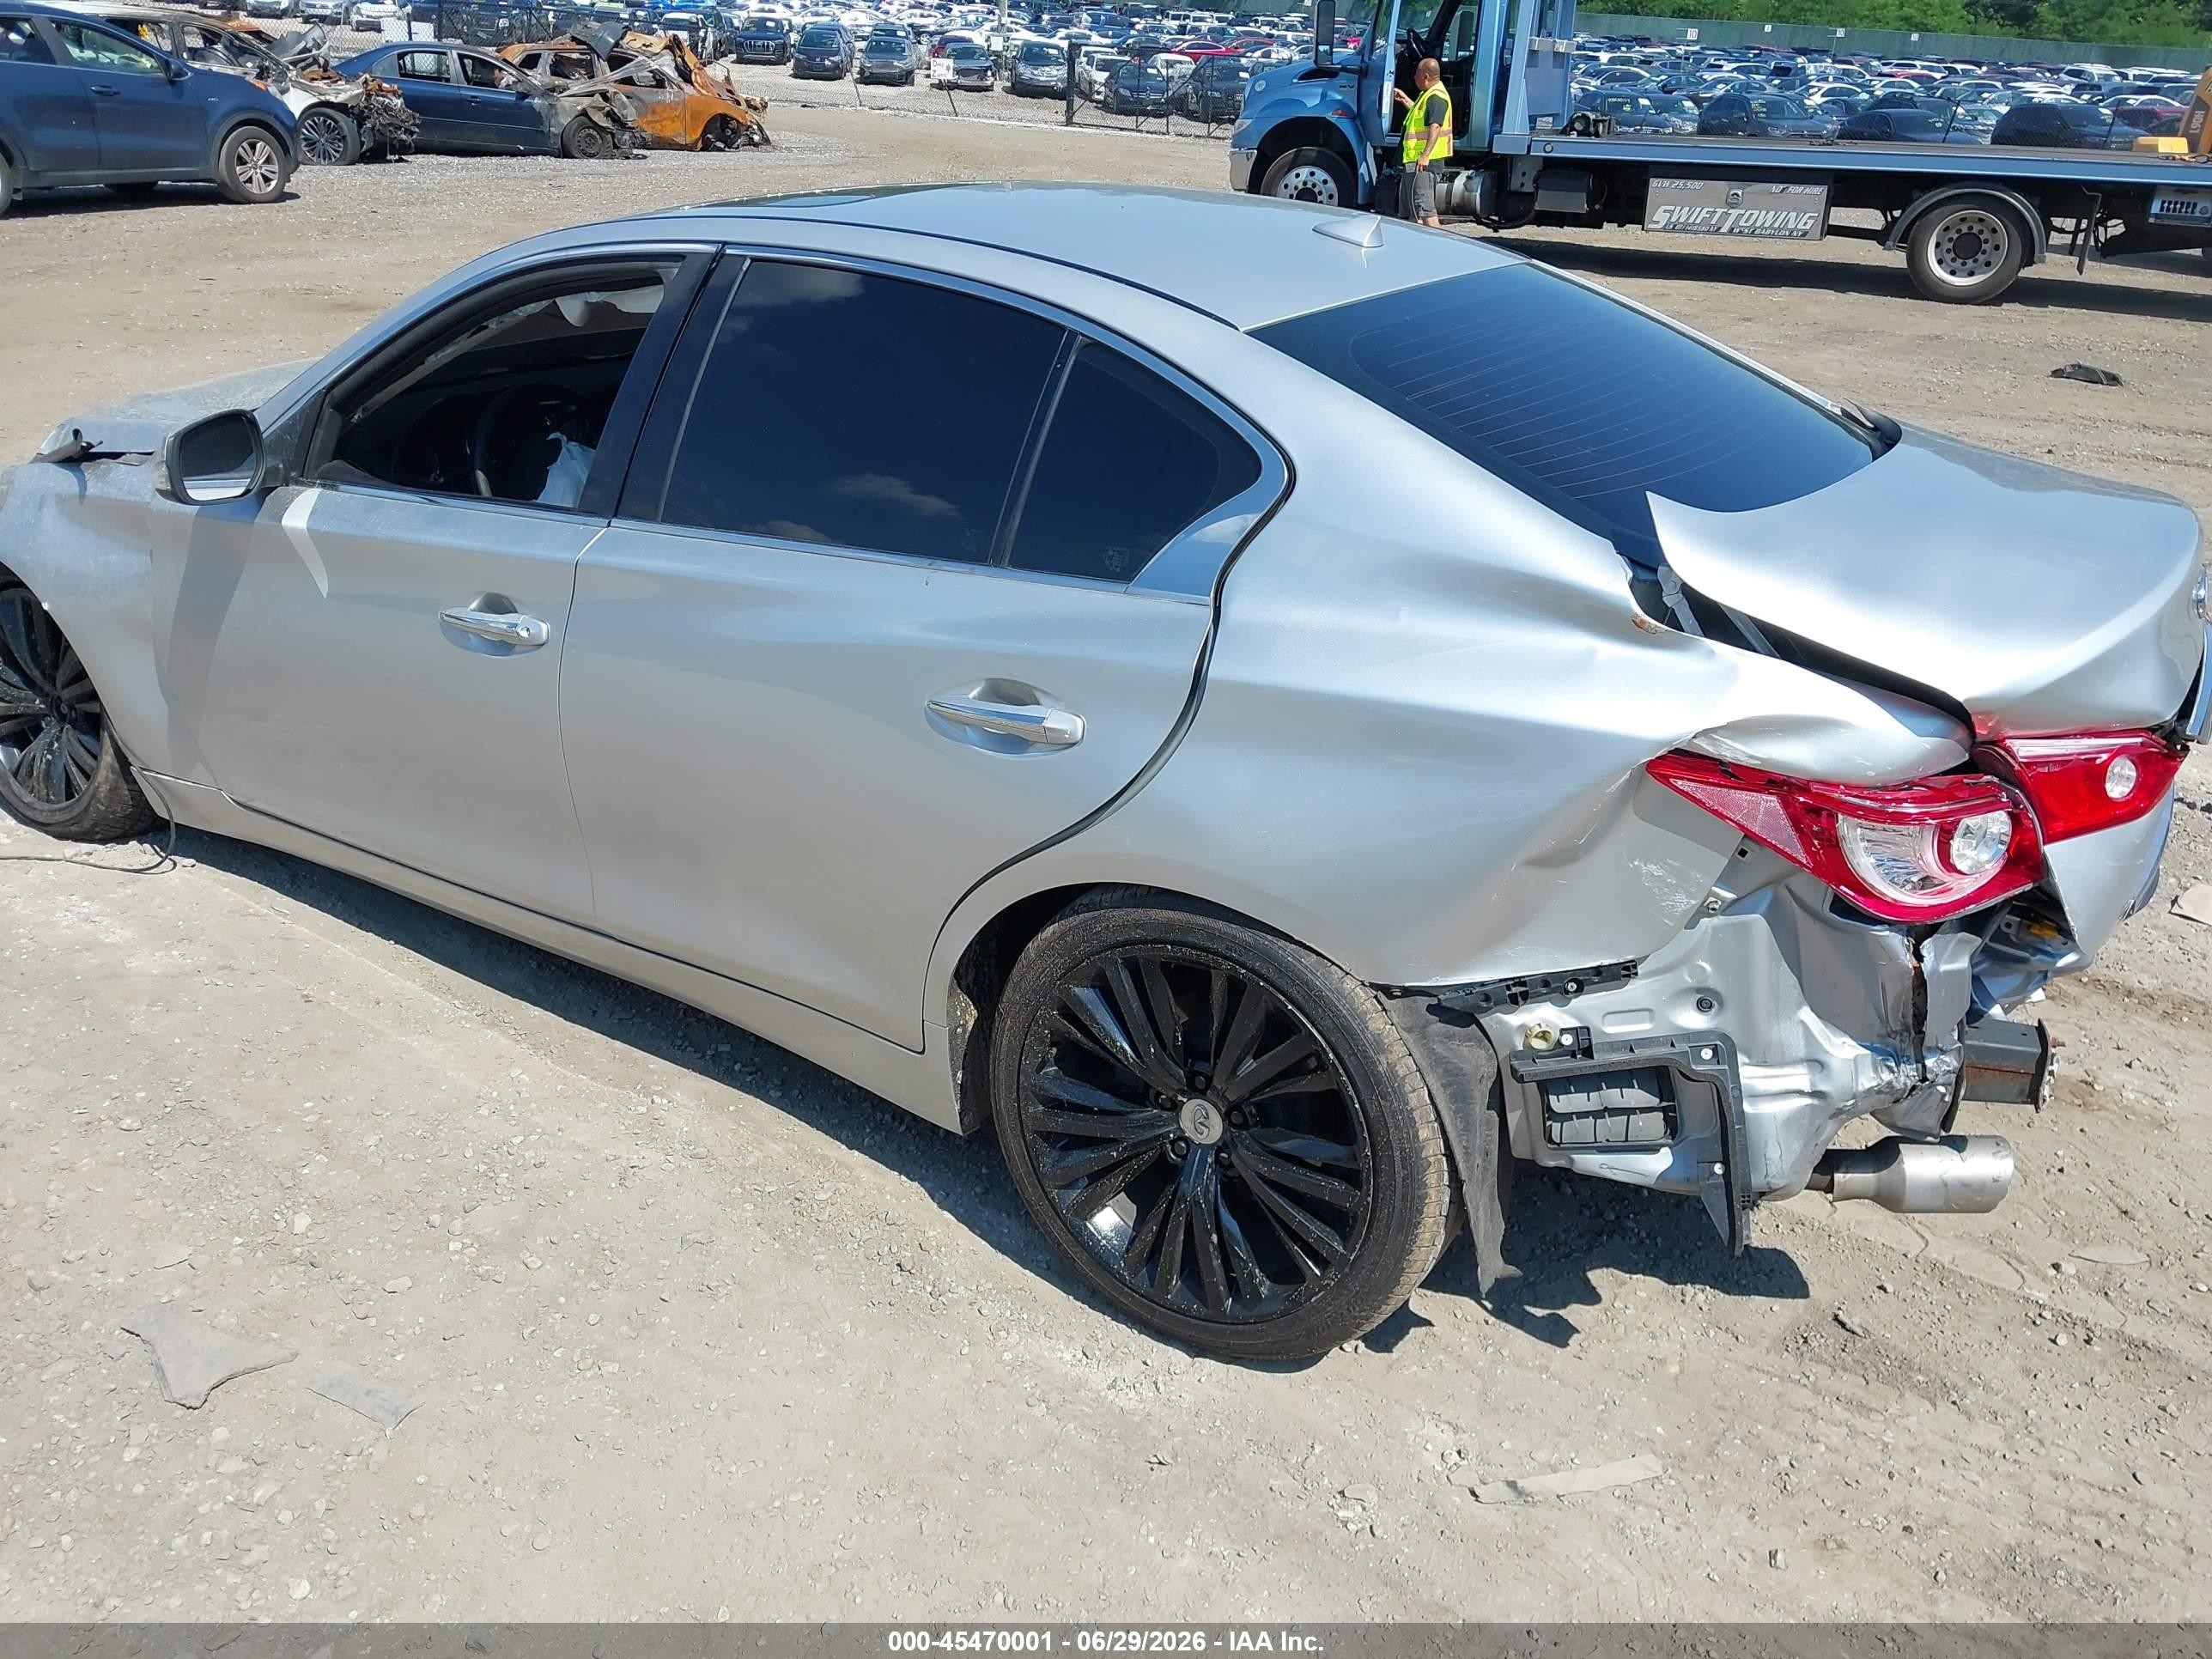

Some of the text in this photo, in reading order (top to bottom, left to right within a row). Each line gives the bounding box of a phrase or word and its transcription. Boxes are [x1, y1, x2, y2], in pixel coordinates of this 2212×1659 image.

[2189, 111, 2205, 133] L90H
[1671, 180, 1704, 189] 25,500
[1787, 185, 1803, 194] FOR
[1803, 186, 1824, 195] HIRE
[1647, 205, 1819, 233] SWIFT TOWING
